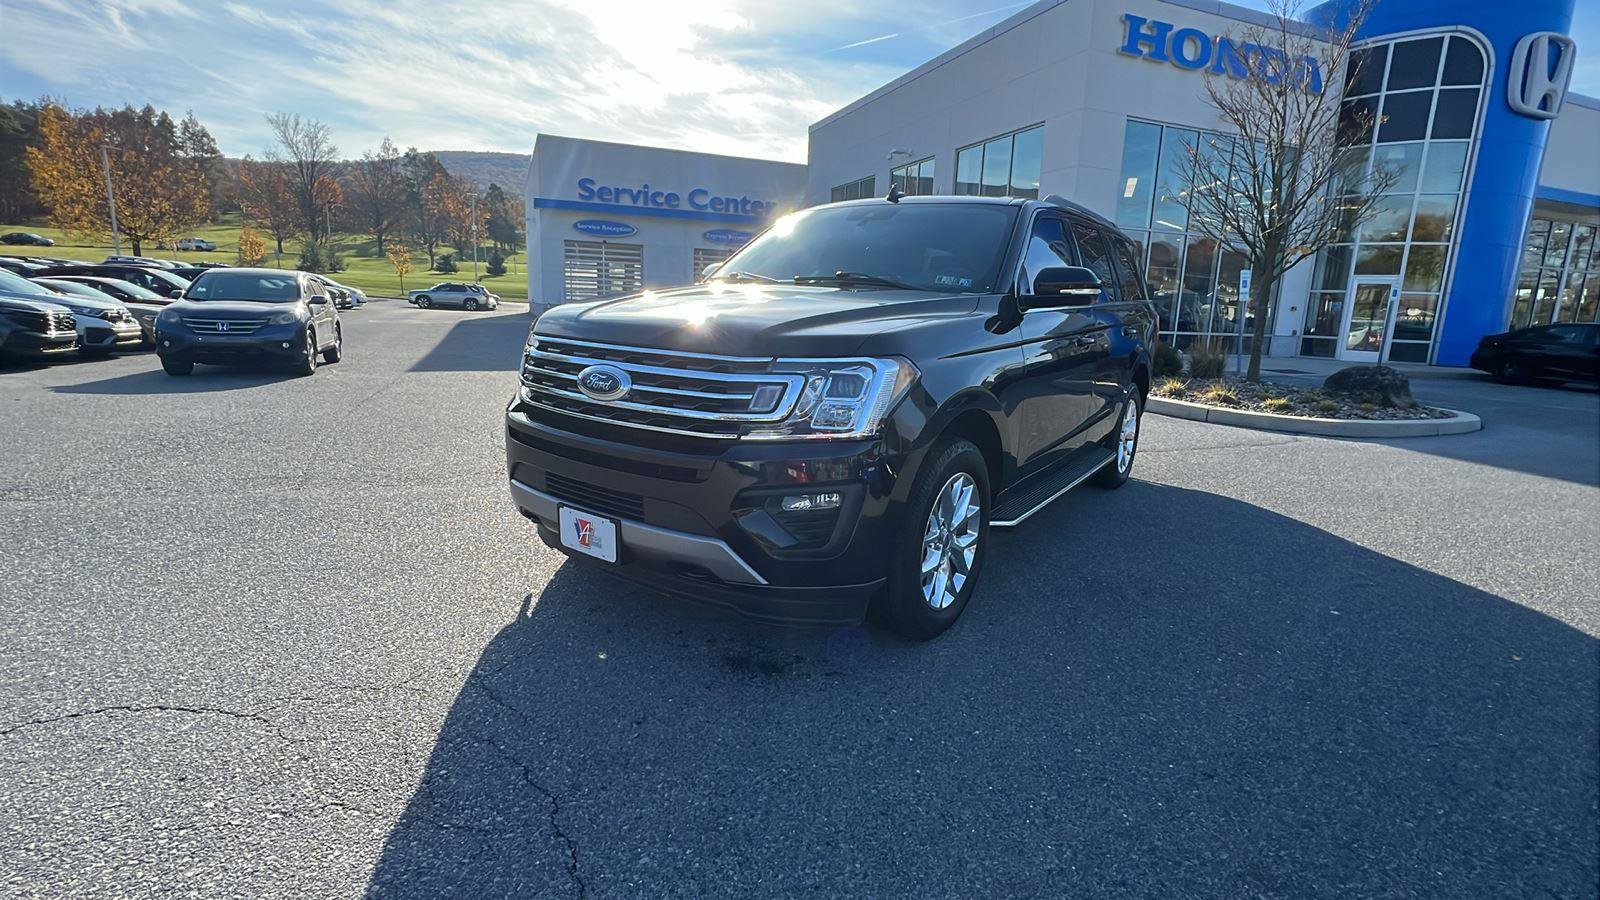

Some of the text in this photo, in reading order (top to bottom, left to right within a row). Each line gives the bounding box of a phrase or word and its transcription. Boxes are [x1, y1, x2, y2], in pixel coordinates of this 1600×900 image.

[1120, 13, 1324, 96] HONDA
[577, 177, 777, 216] Service Center
[577, 222, 633, 233] Service Reception
[586, 373, 613, 391] Ford
